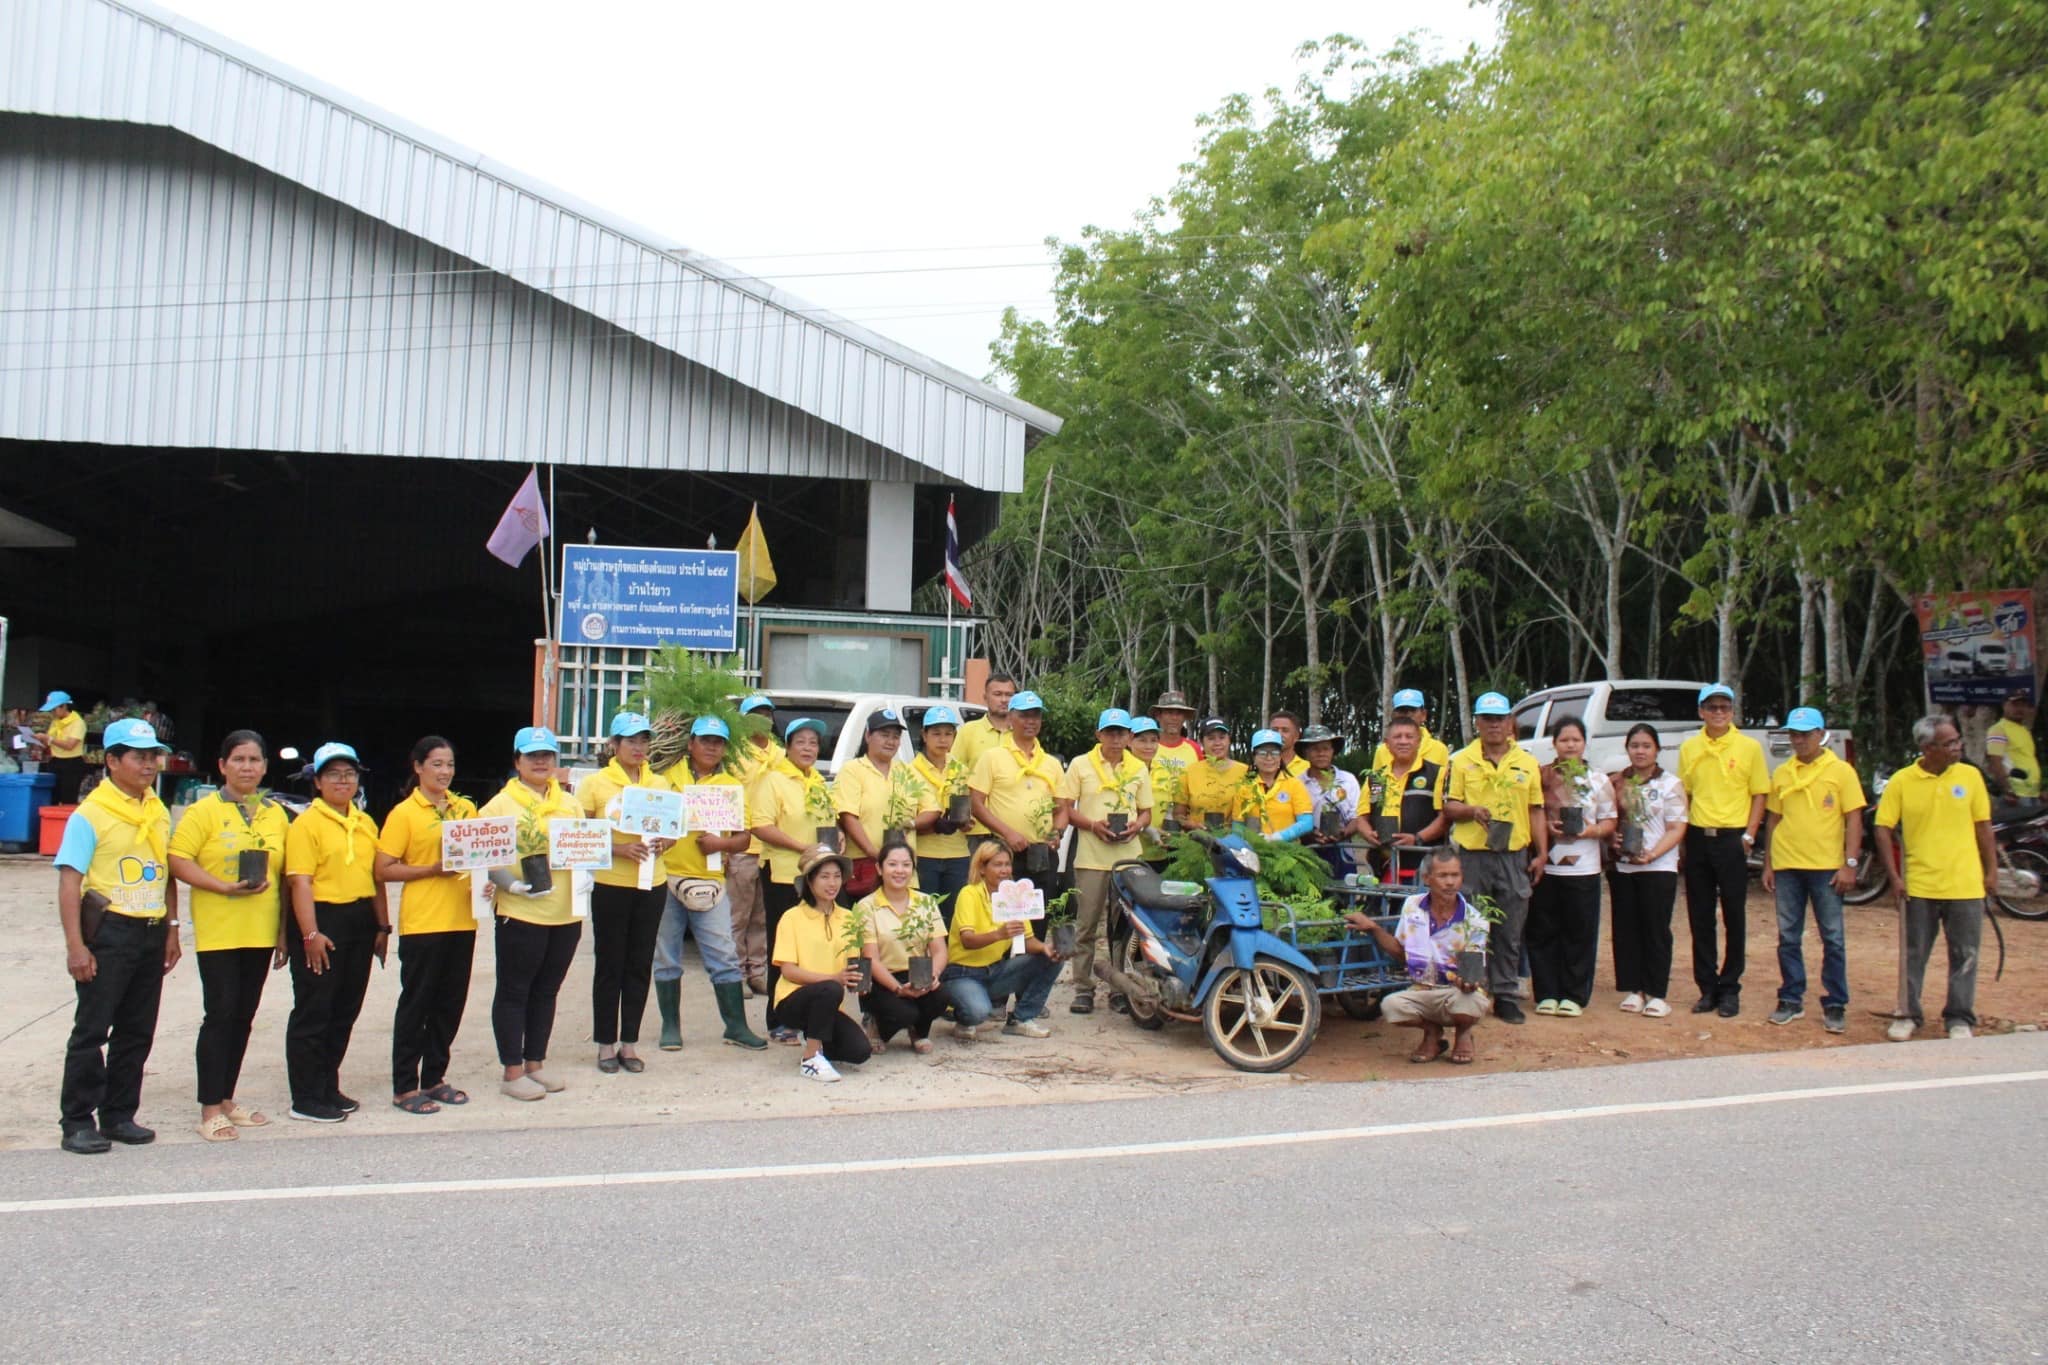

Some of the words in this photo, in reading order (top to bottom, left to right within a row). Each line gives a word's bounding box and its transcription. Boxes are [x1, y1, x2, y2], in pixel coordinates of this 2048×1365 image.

[450, 823, 509, 842] ผู้นำต้อง
[471, 836, 511, 849] ทำก่อน
